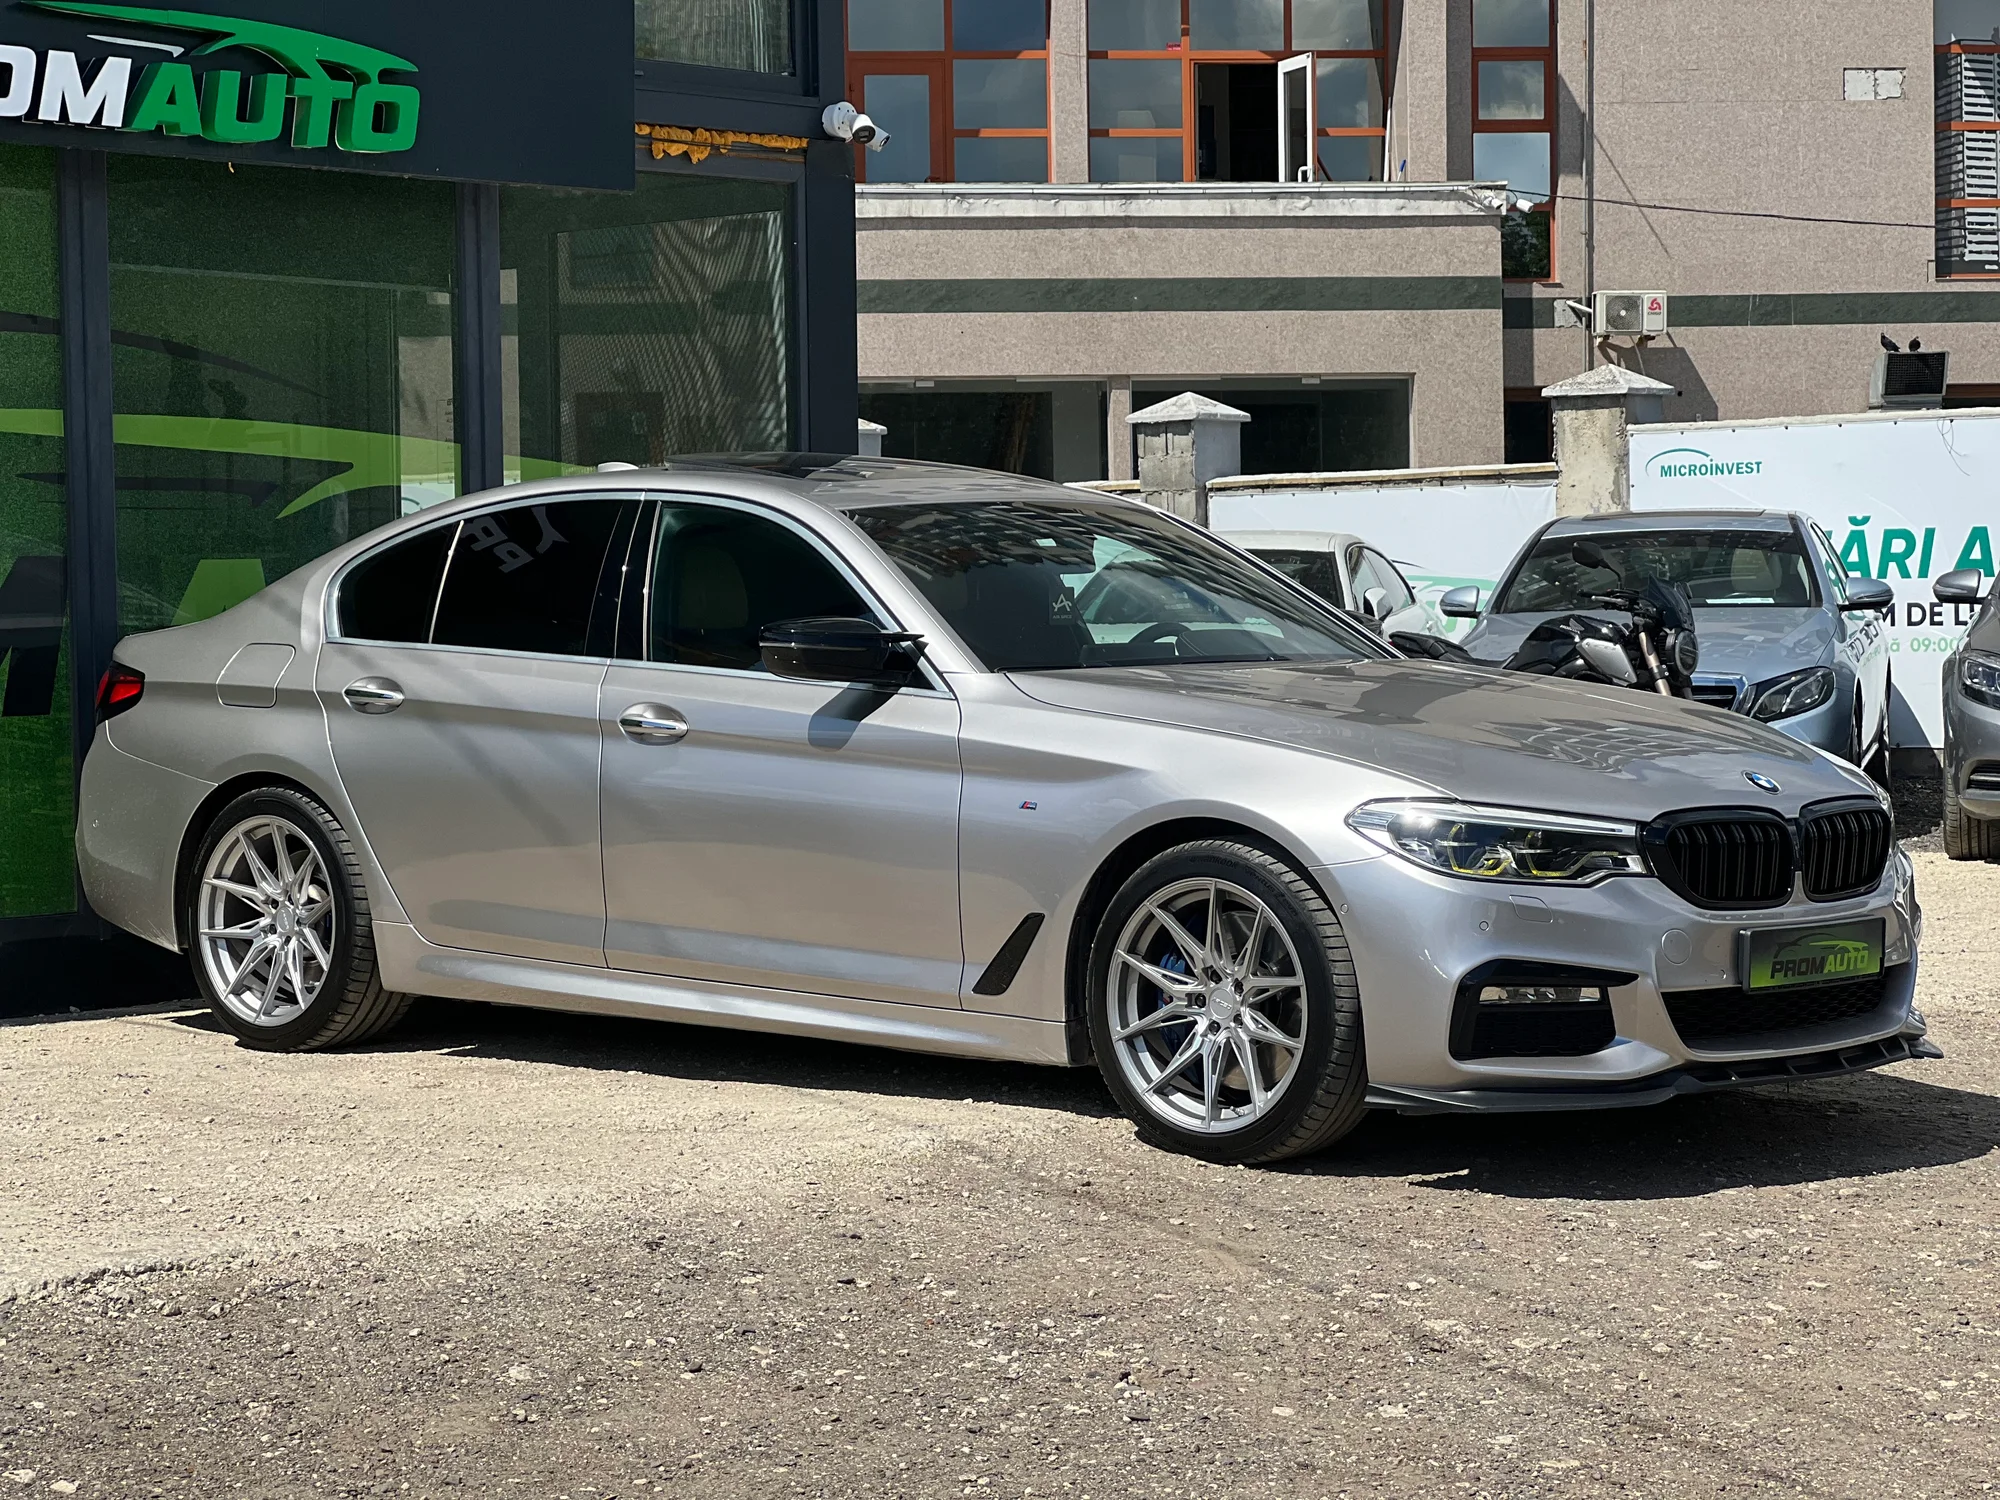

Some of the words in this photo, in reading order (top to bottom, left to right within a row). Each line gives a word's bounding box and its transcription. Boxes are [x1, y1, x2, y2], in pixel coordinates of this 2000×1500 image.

[1824, 515, 1936, 579] ĂRI
[1907, 602, 1944, 627] DE
[1770, 949, 1868, 979] PROMAUTO
